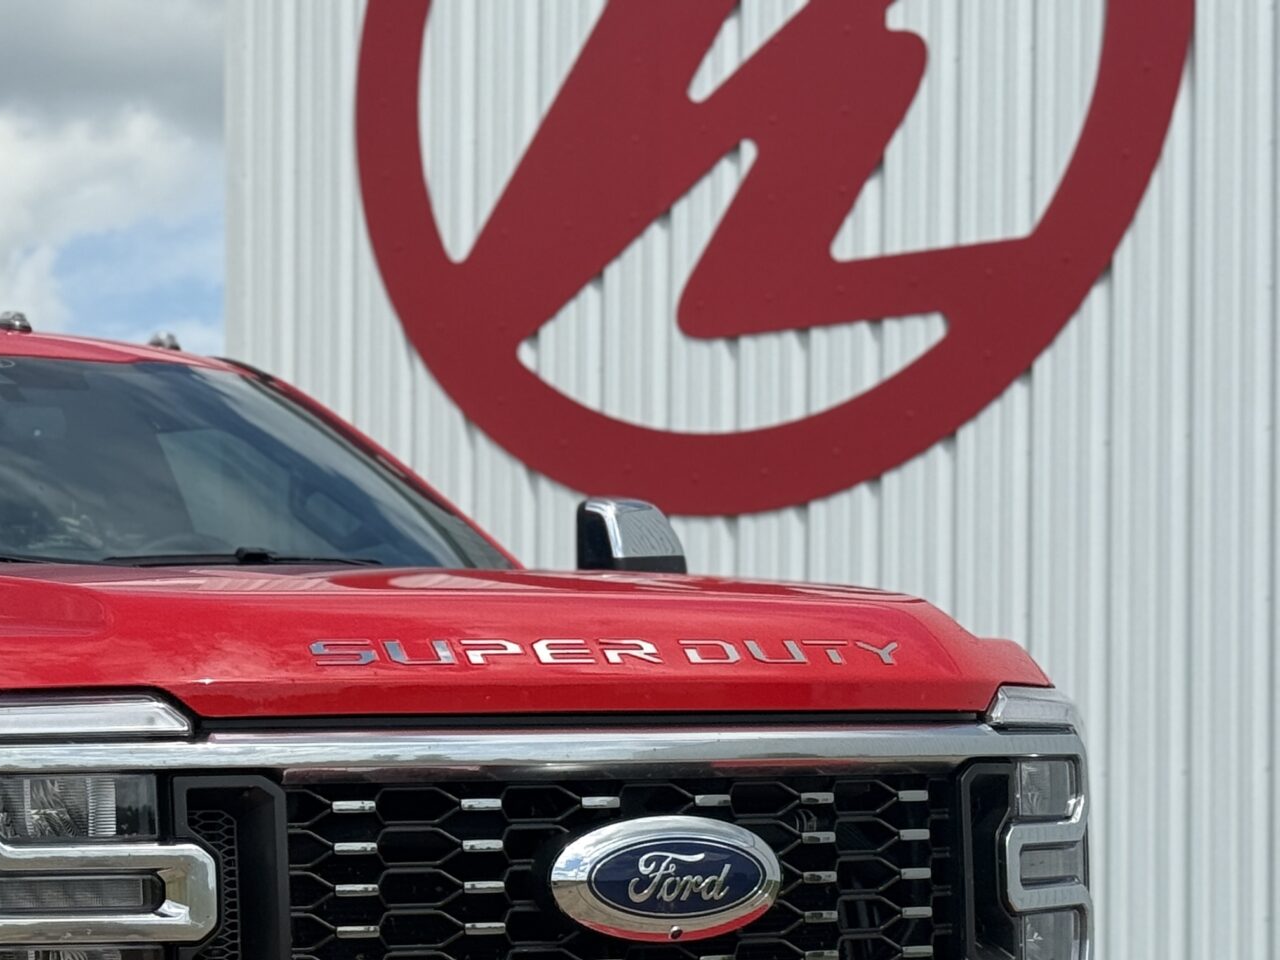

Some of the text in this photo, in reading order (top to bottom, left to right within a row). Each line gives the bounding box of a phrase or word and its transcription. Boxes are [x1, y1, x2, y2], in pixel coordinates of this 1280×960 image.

[308, 639, 899, 665] SUPER DUTY
[628, 851, 732, 904] Ford
